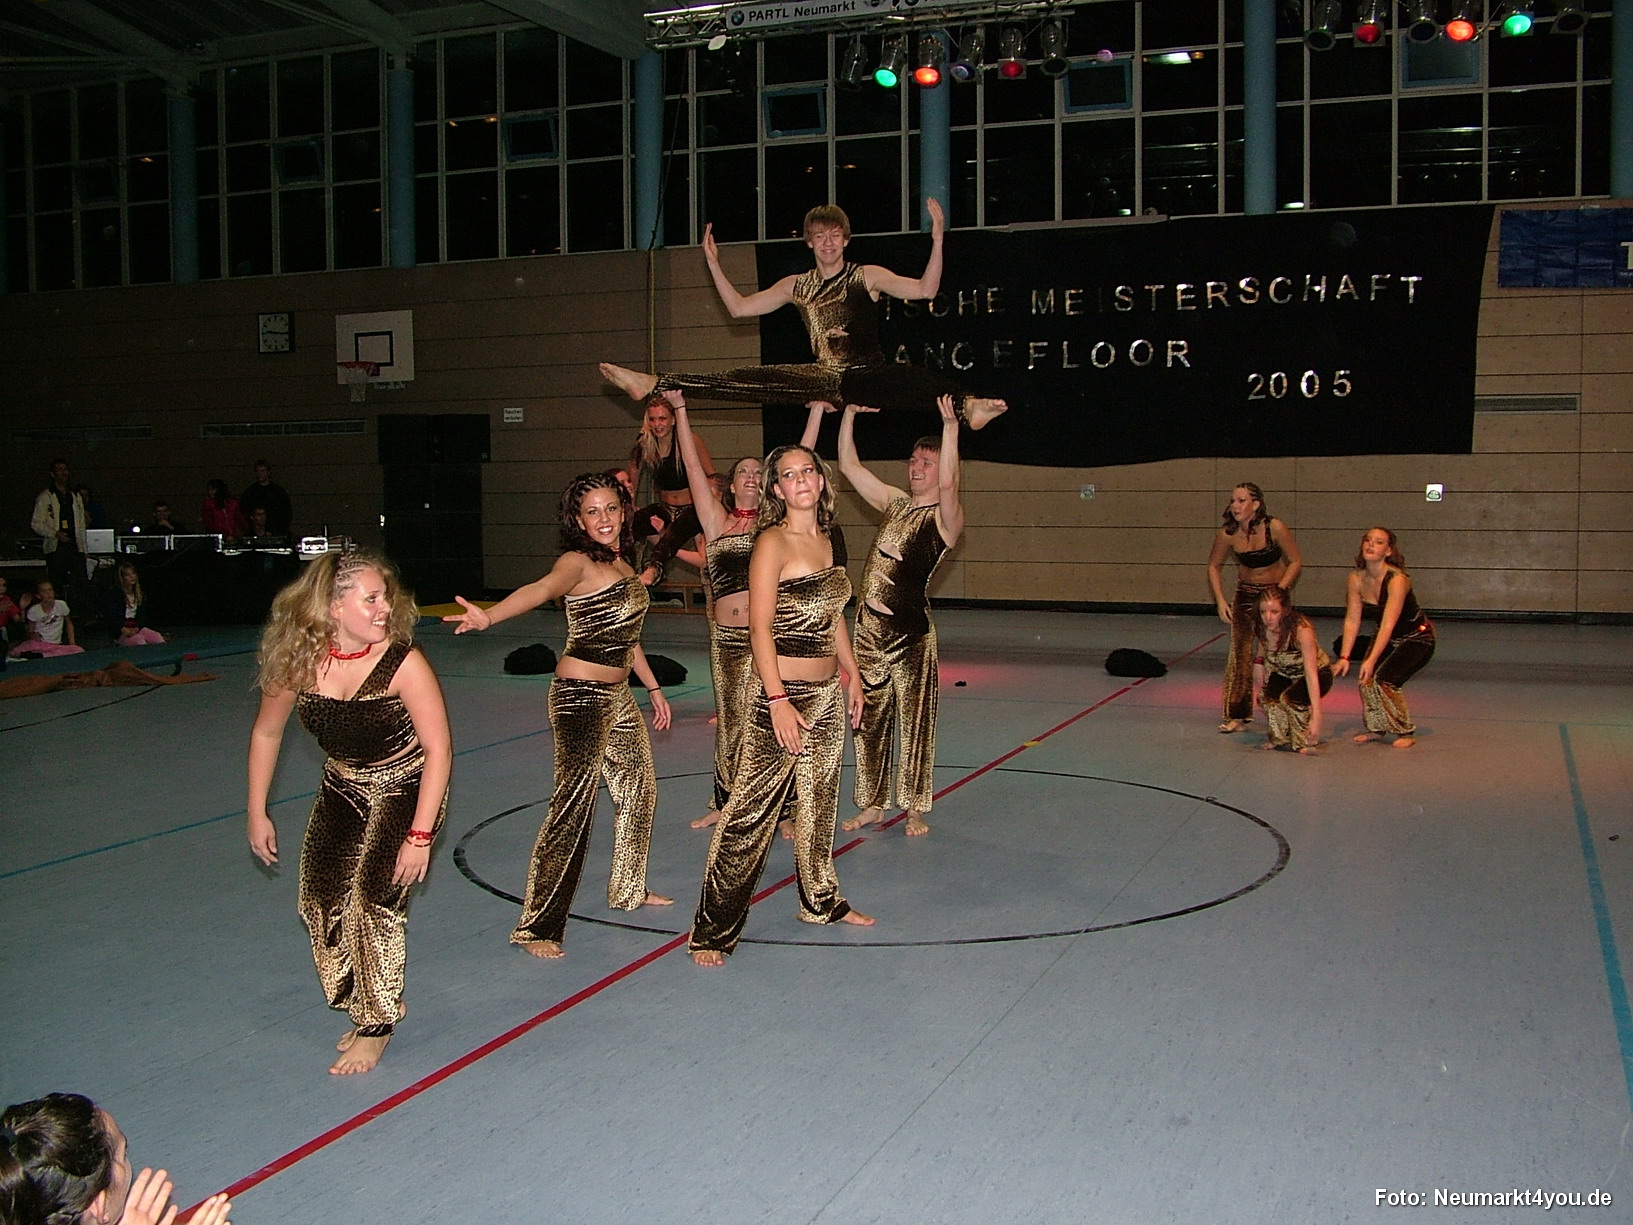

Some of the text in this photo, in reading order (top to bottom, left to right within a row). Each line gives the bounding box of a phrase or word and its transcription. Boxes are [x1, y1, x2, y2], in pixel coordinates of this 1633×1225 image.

[749, 0, 856, 22] PARTL Neumarkt
[1032, 273, 1423, 315] MEISTERSCHAFT
[894, 338, 1191, 371] ANCEFLOOR
[1247, 369, 1353, 400] 2005
